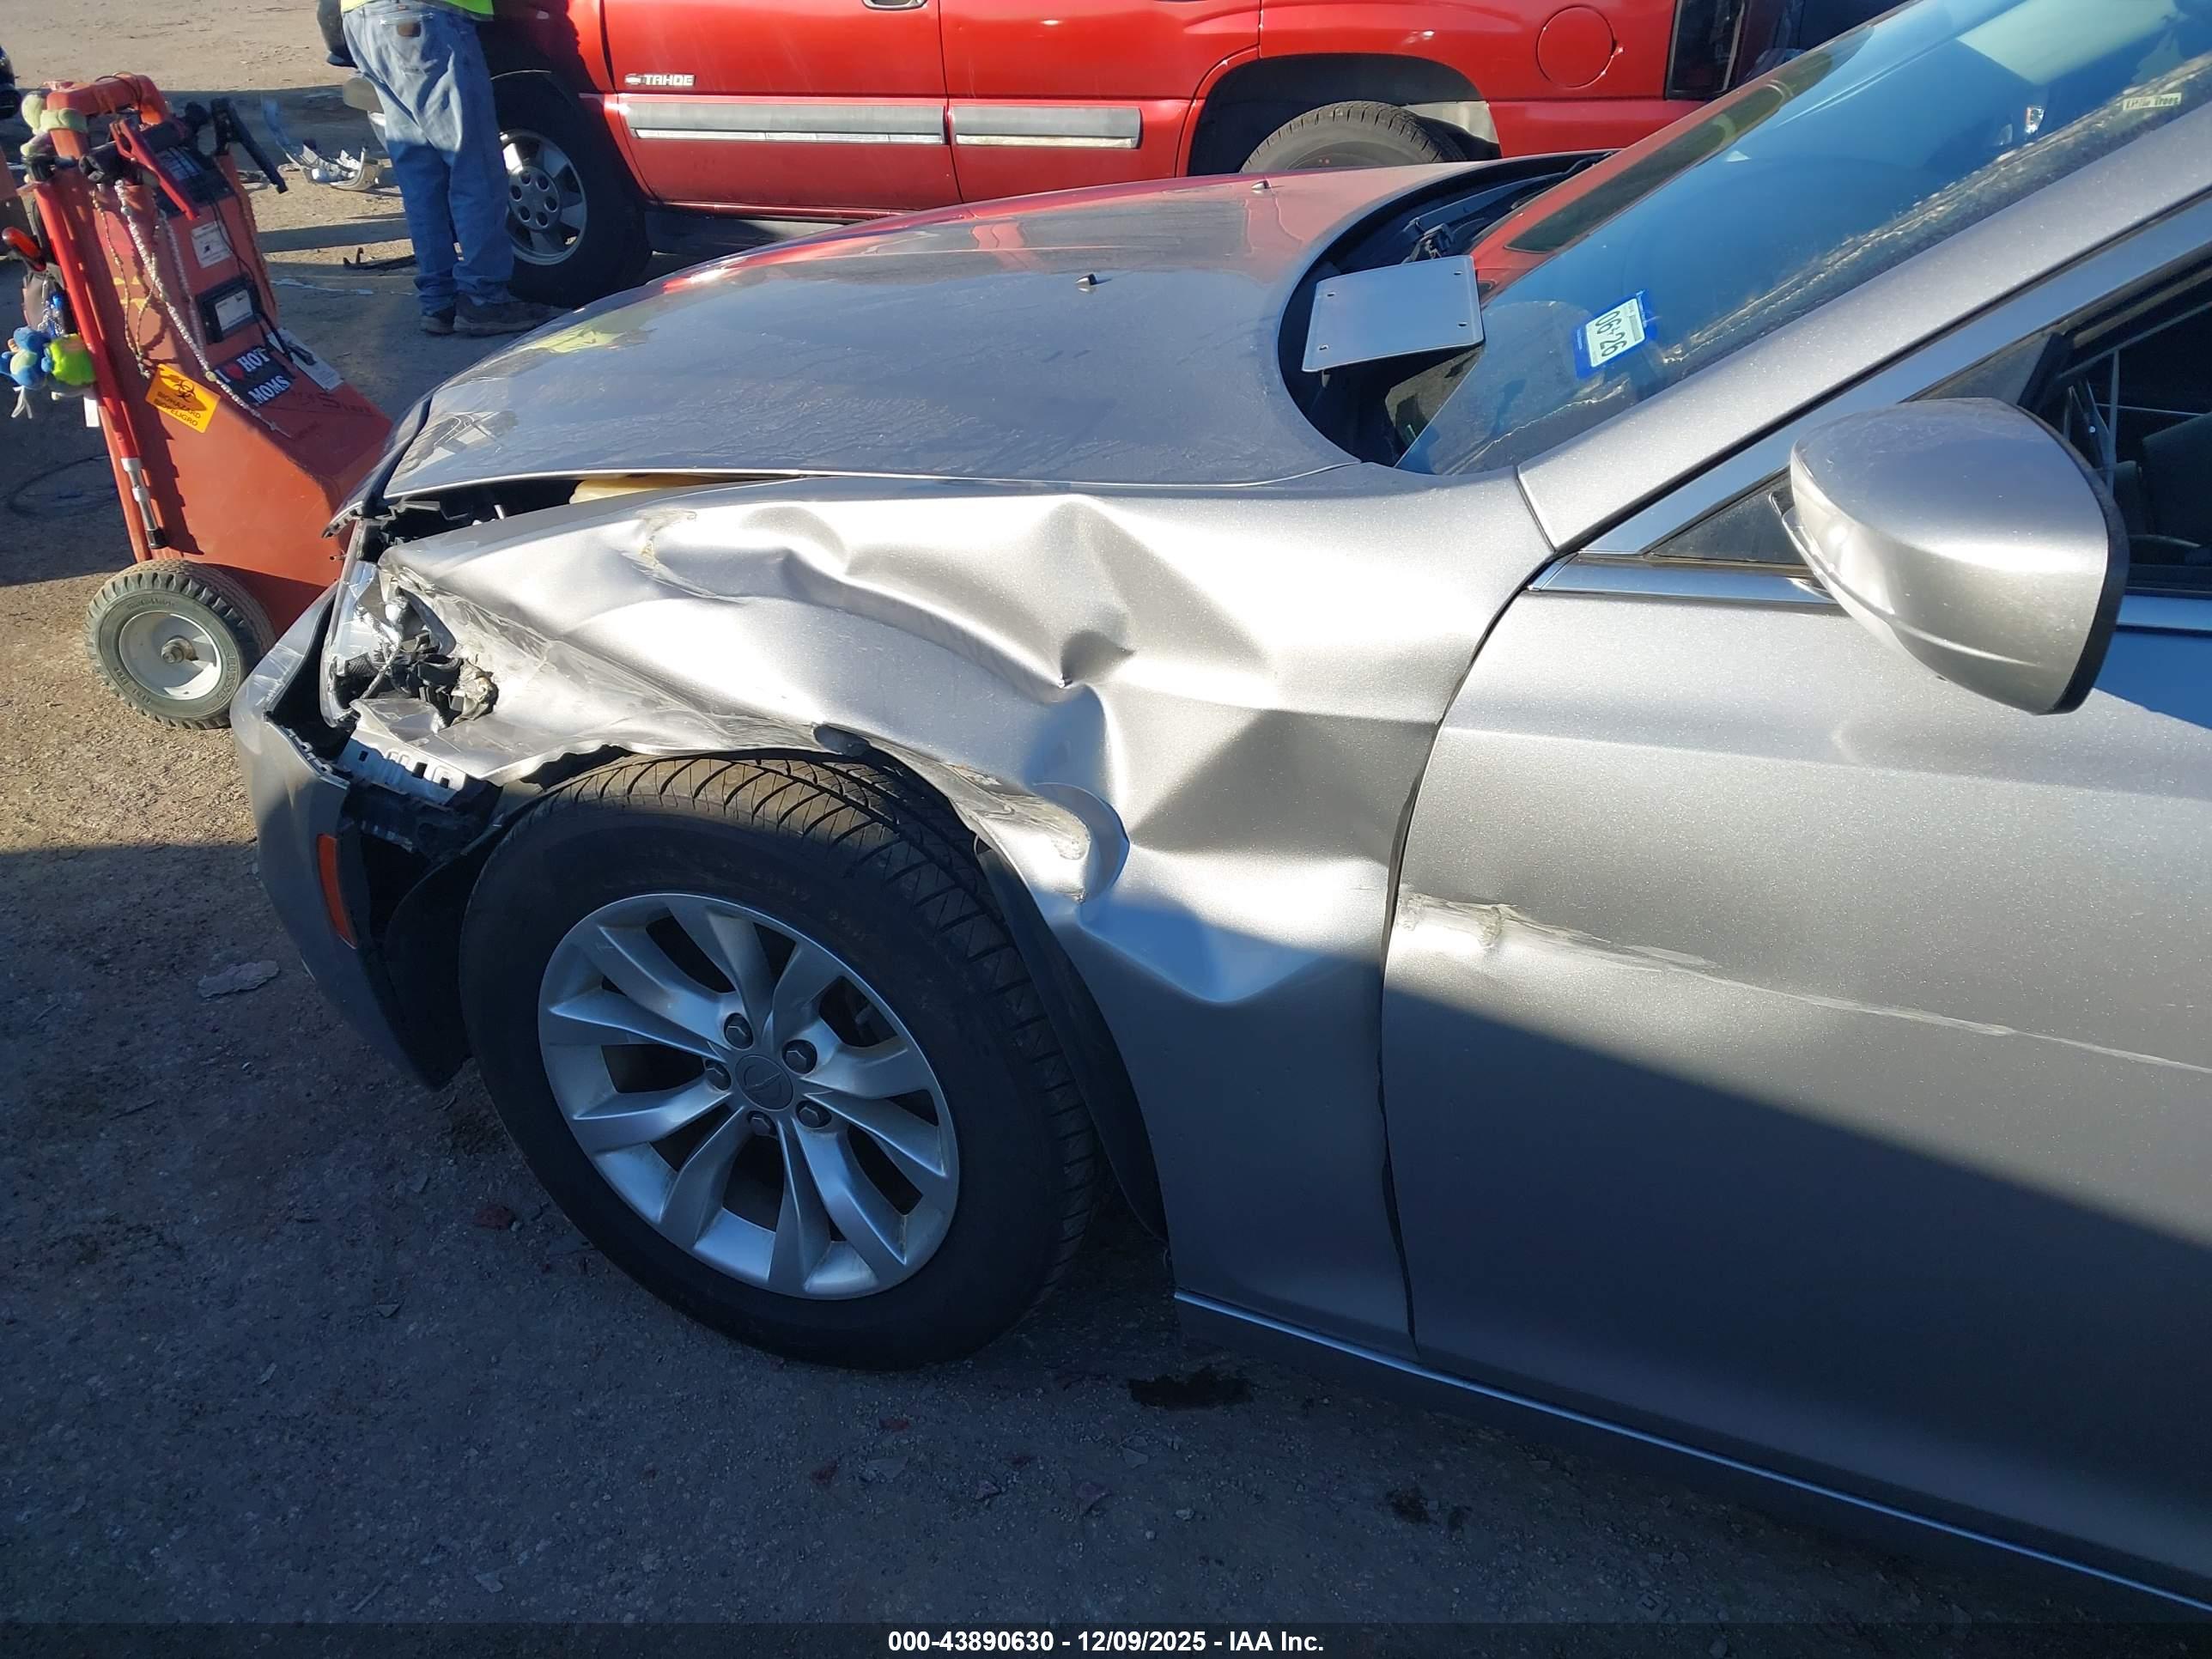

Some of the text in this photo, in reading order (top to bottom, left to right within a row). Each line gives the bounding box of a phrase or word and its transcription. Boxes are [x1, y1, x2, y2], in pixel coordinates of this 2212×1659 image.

[644, 73, 696, 87] TAHOE
[1595, 310, 1628, 357] 06 26
[236, 346, 270, 373] HOT
[247, 374, 291, 406] MOMS
